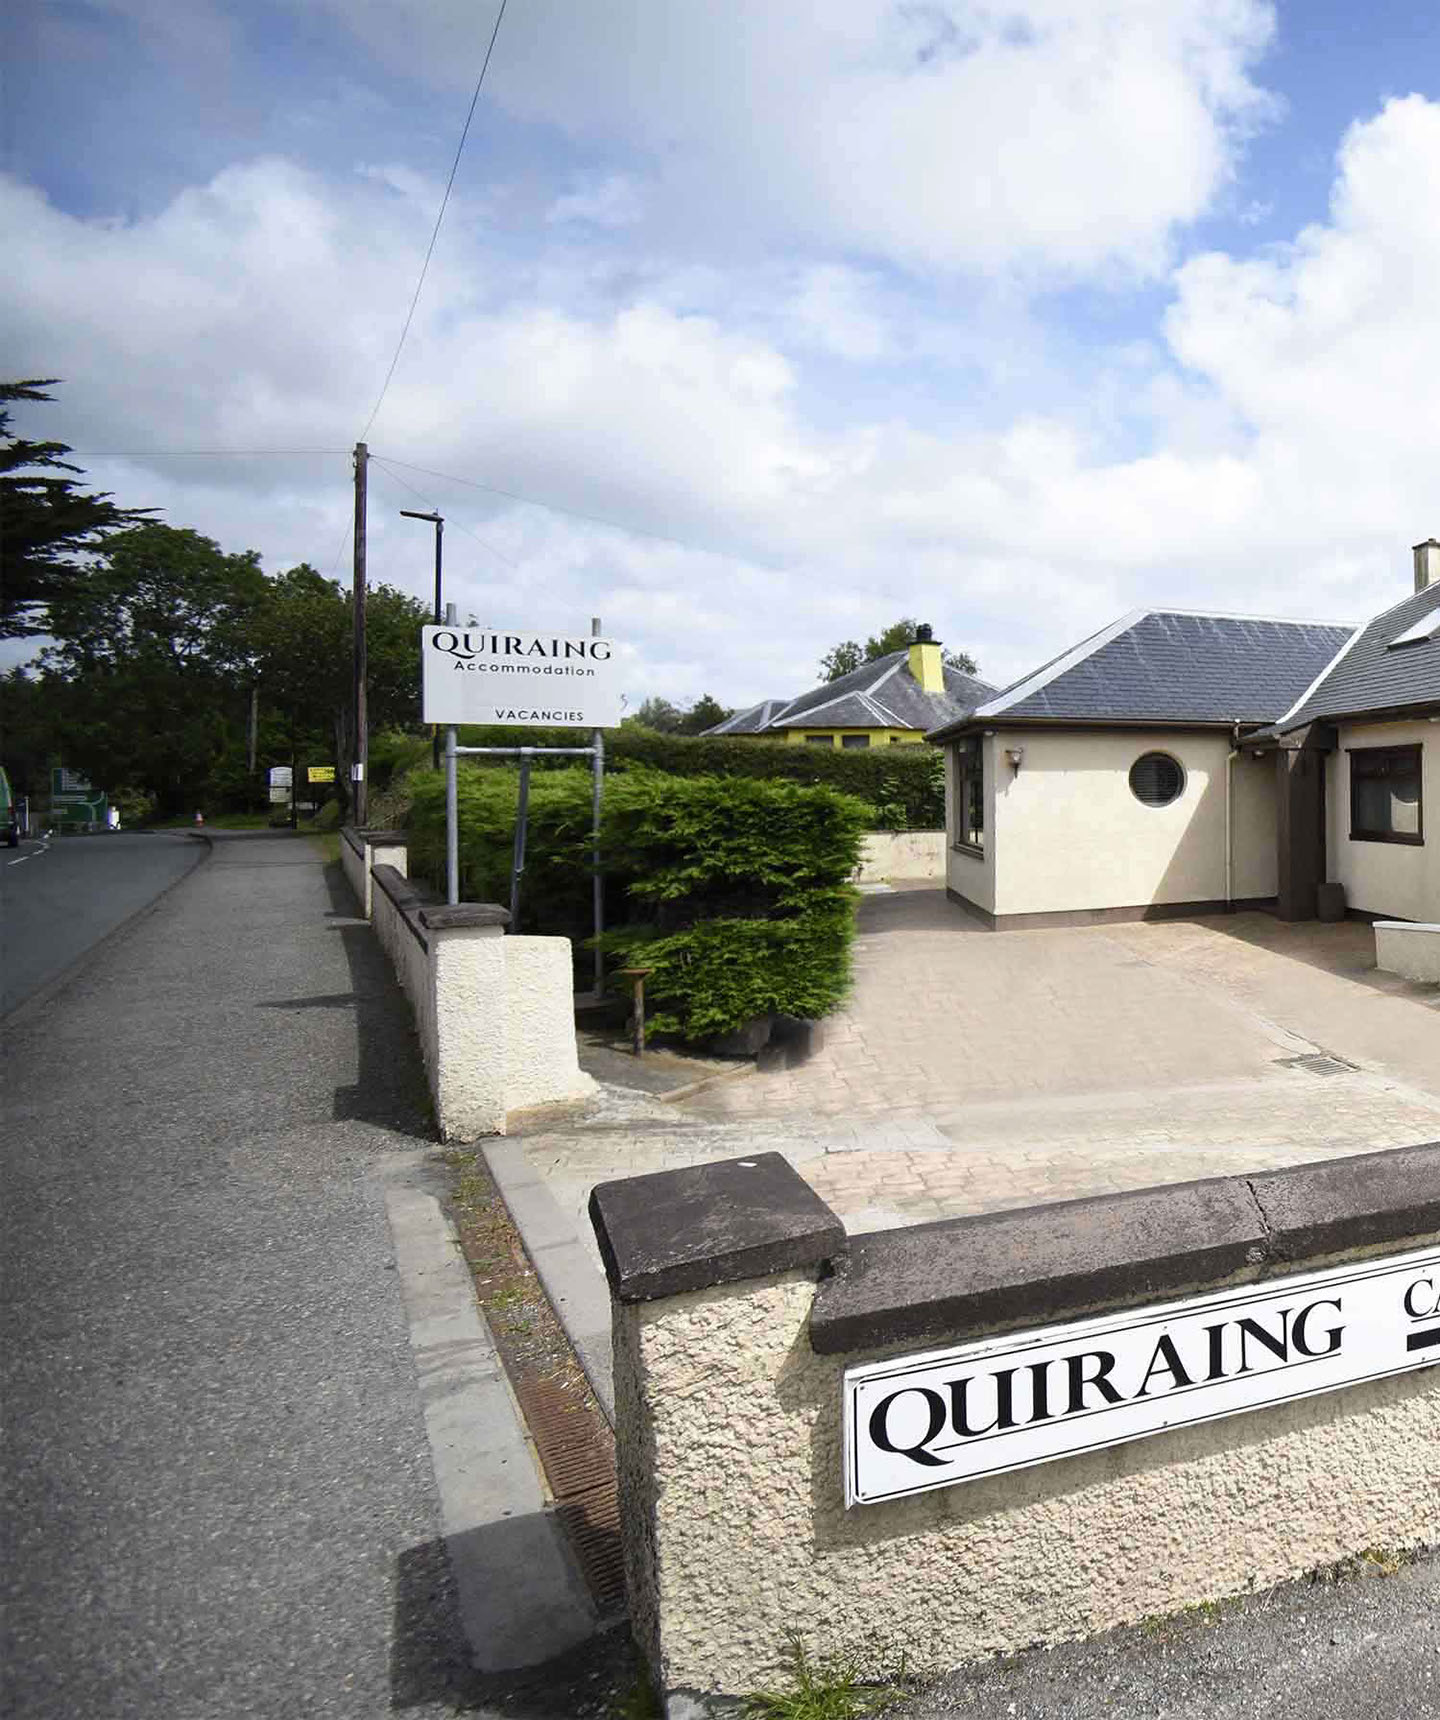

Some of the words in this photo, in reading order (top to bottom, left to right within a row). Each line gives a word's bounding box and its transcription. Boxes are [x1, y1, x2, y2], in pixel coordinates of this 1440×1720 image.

[432, 631, 612, 660] QUIRAING
[453, 660, 596, 677] Accommodation
[495, 709, 585, 722] VACANCIES
[868, 1297, 1346, 1467] QUIRAING
